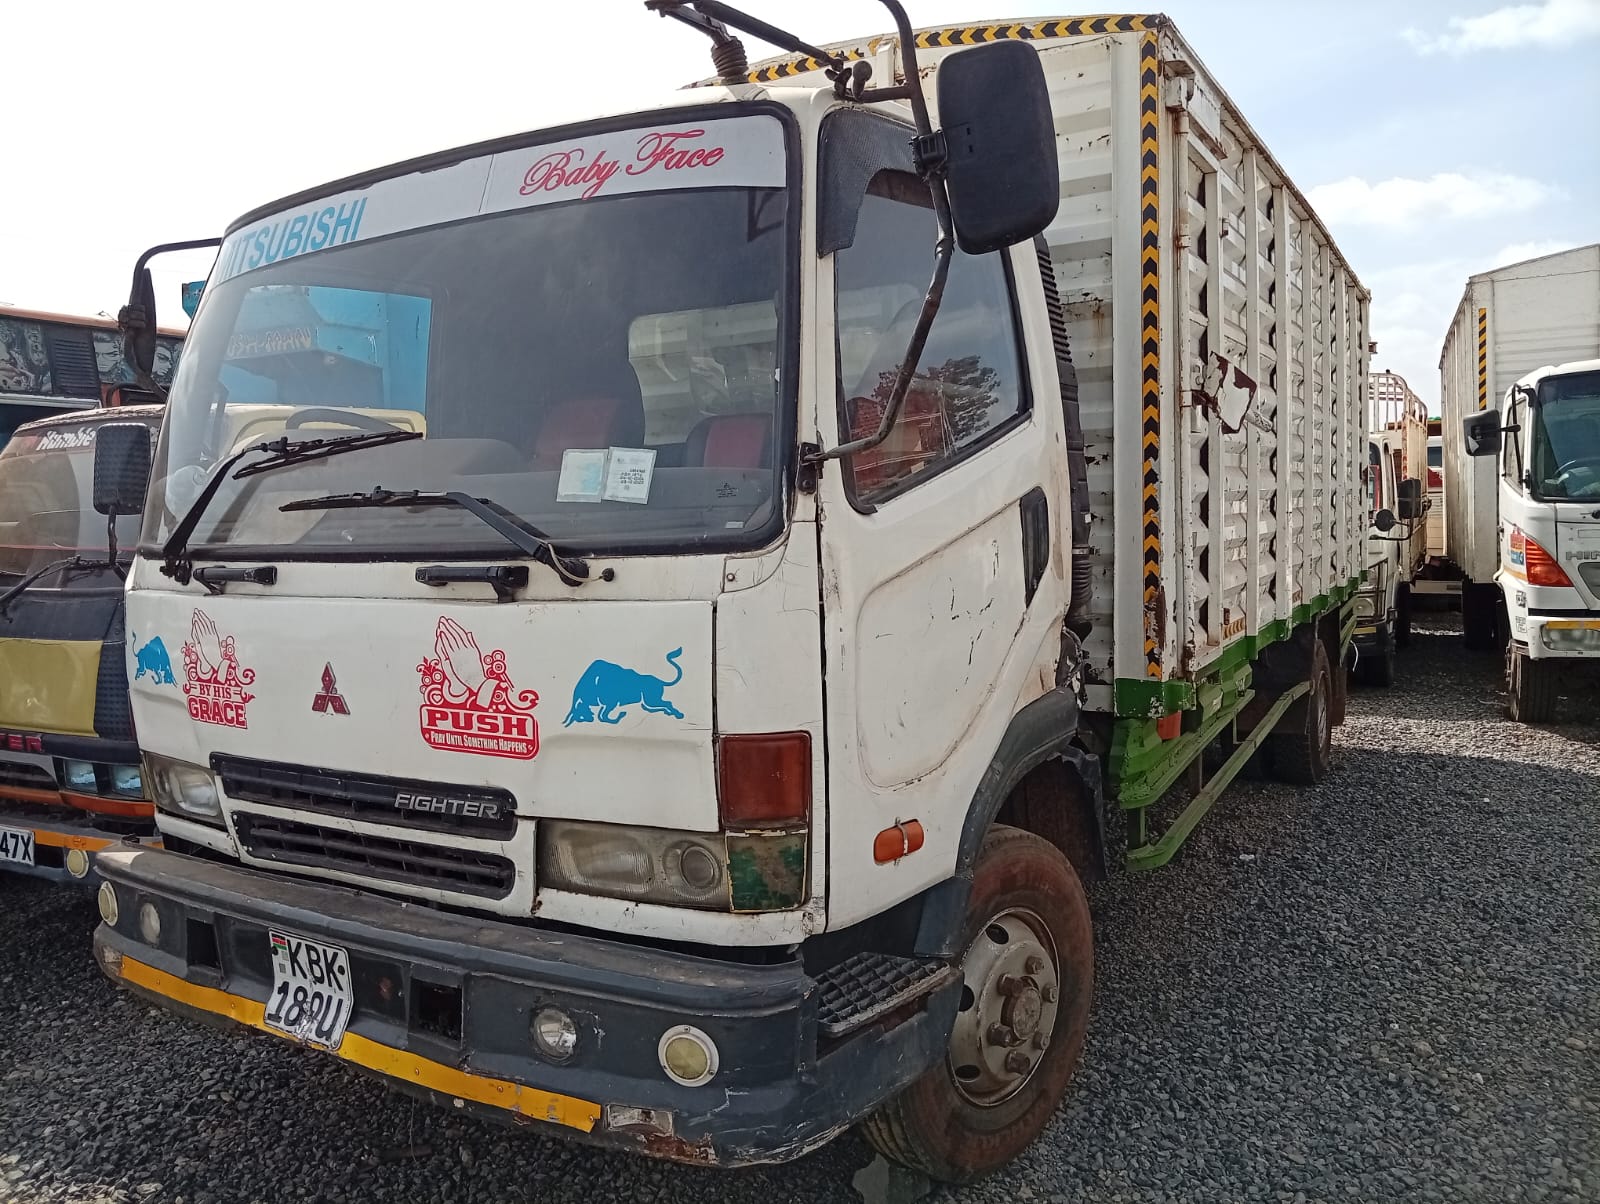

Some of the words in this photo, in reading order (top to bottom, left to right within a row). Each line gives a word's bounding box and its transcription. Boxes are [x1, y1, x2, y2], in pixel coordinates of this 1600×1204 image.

[519, 148, 620, 200] Baby
[625, 129, 725, 175] Face
[200, 684, 211, 696] BY
[213, 685, 232, 699] HIS
[189, 697, 247, 728] GRACE
[427, 709, 528, 737] PUSH
[394, 792, 501, 820] FIGHTER
[287, 938, 344, 991] KBK
